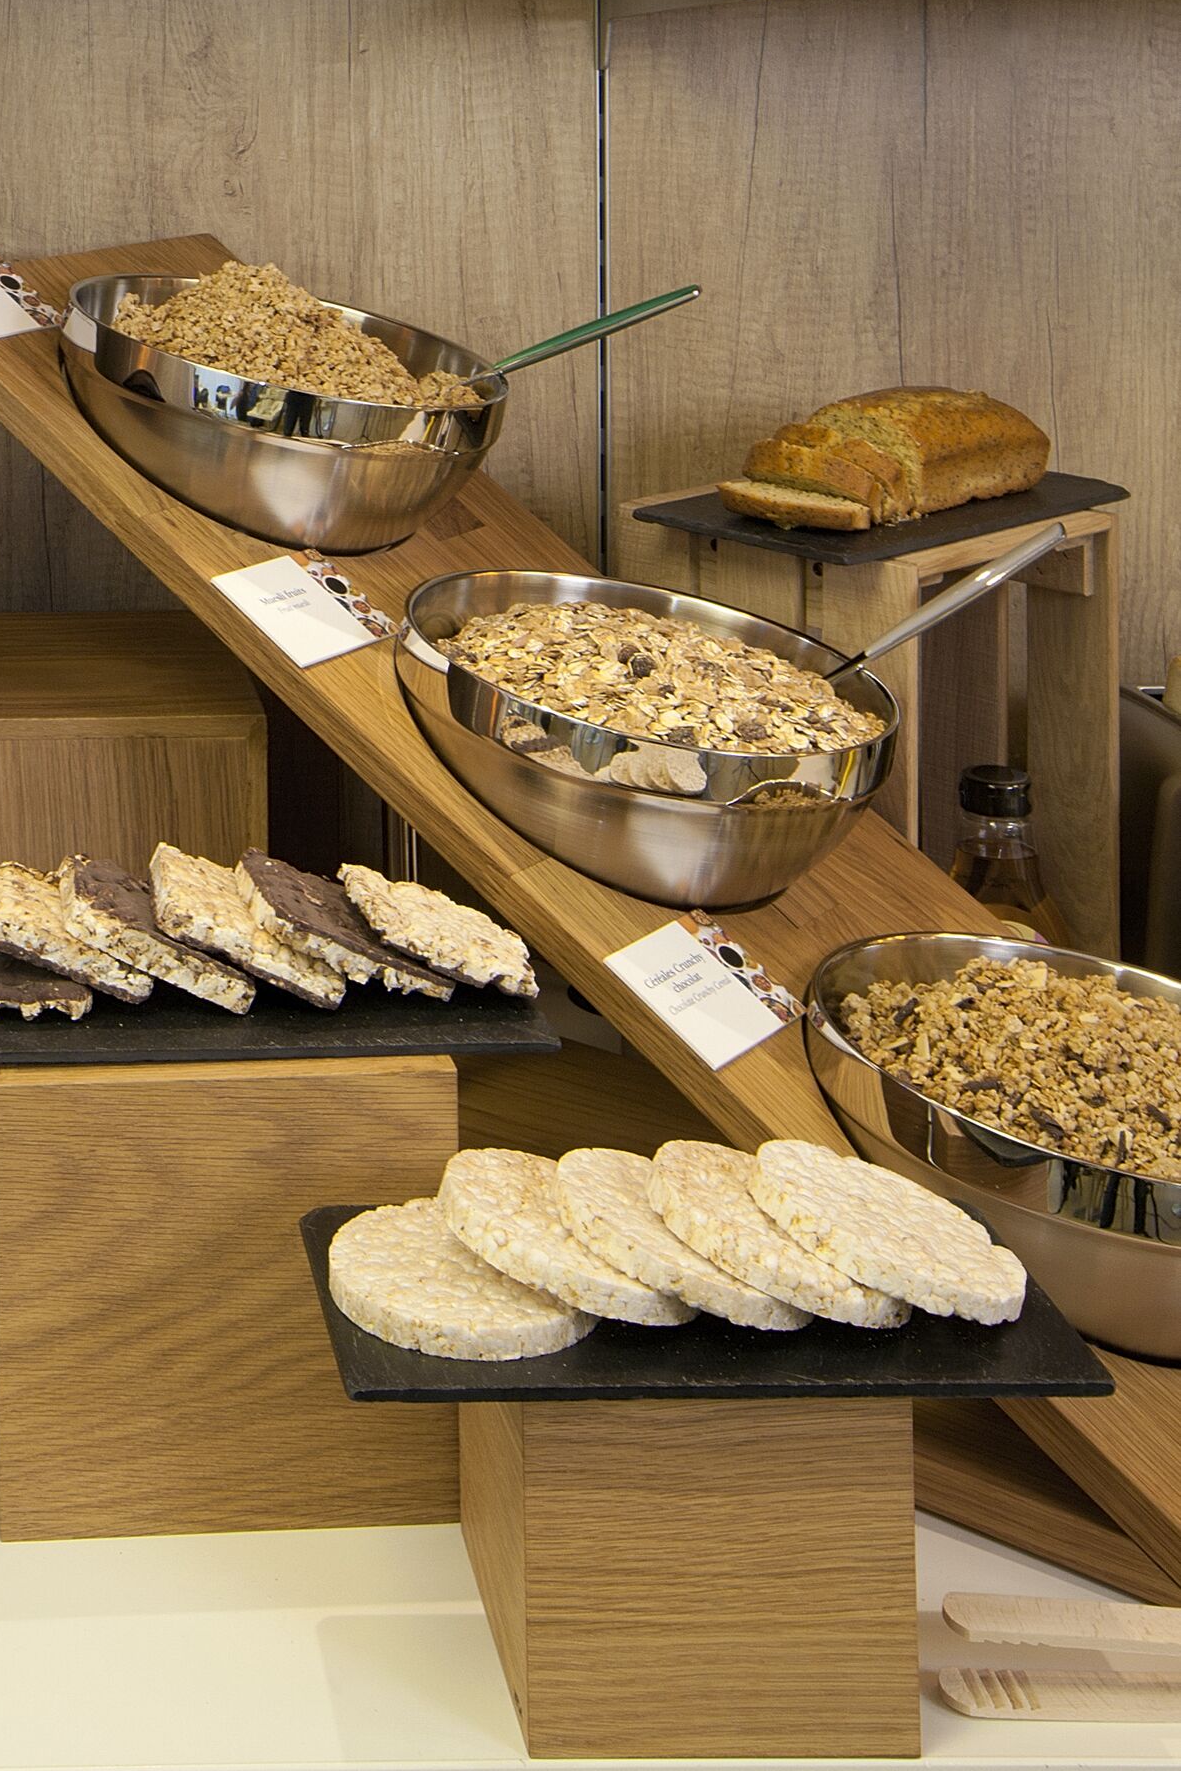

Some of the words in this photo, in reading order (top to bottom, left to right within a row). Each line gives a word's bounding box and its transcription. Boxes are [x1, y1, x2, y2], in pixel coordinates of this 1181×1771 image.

[644, 968, 676, 989] Céréales
[674, 953, 705, 973] Crunchy
[674, 973, 703, 993] chocolat
